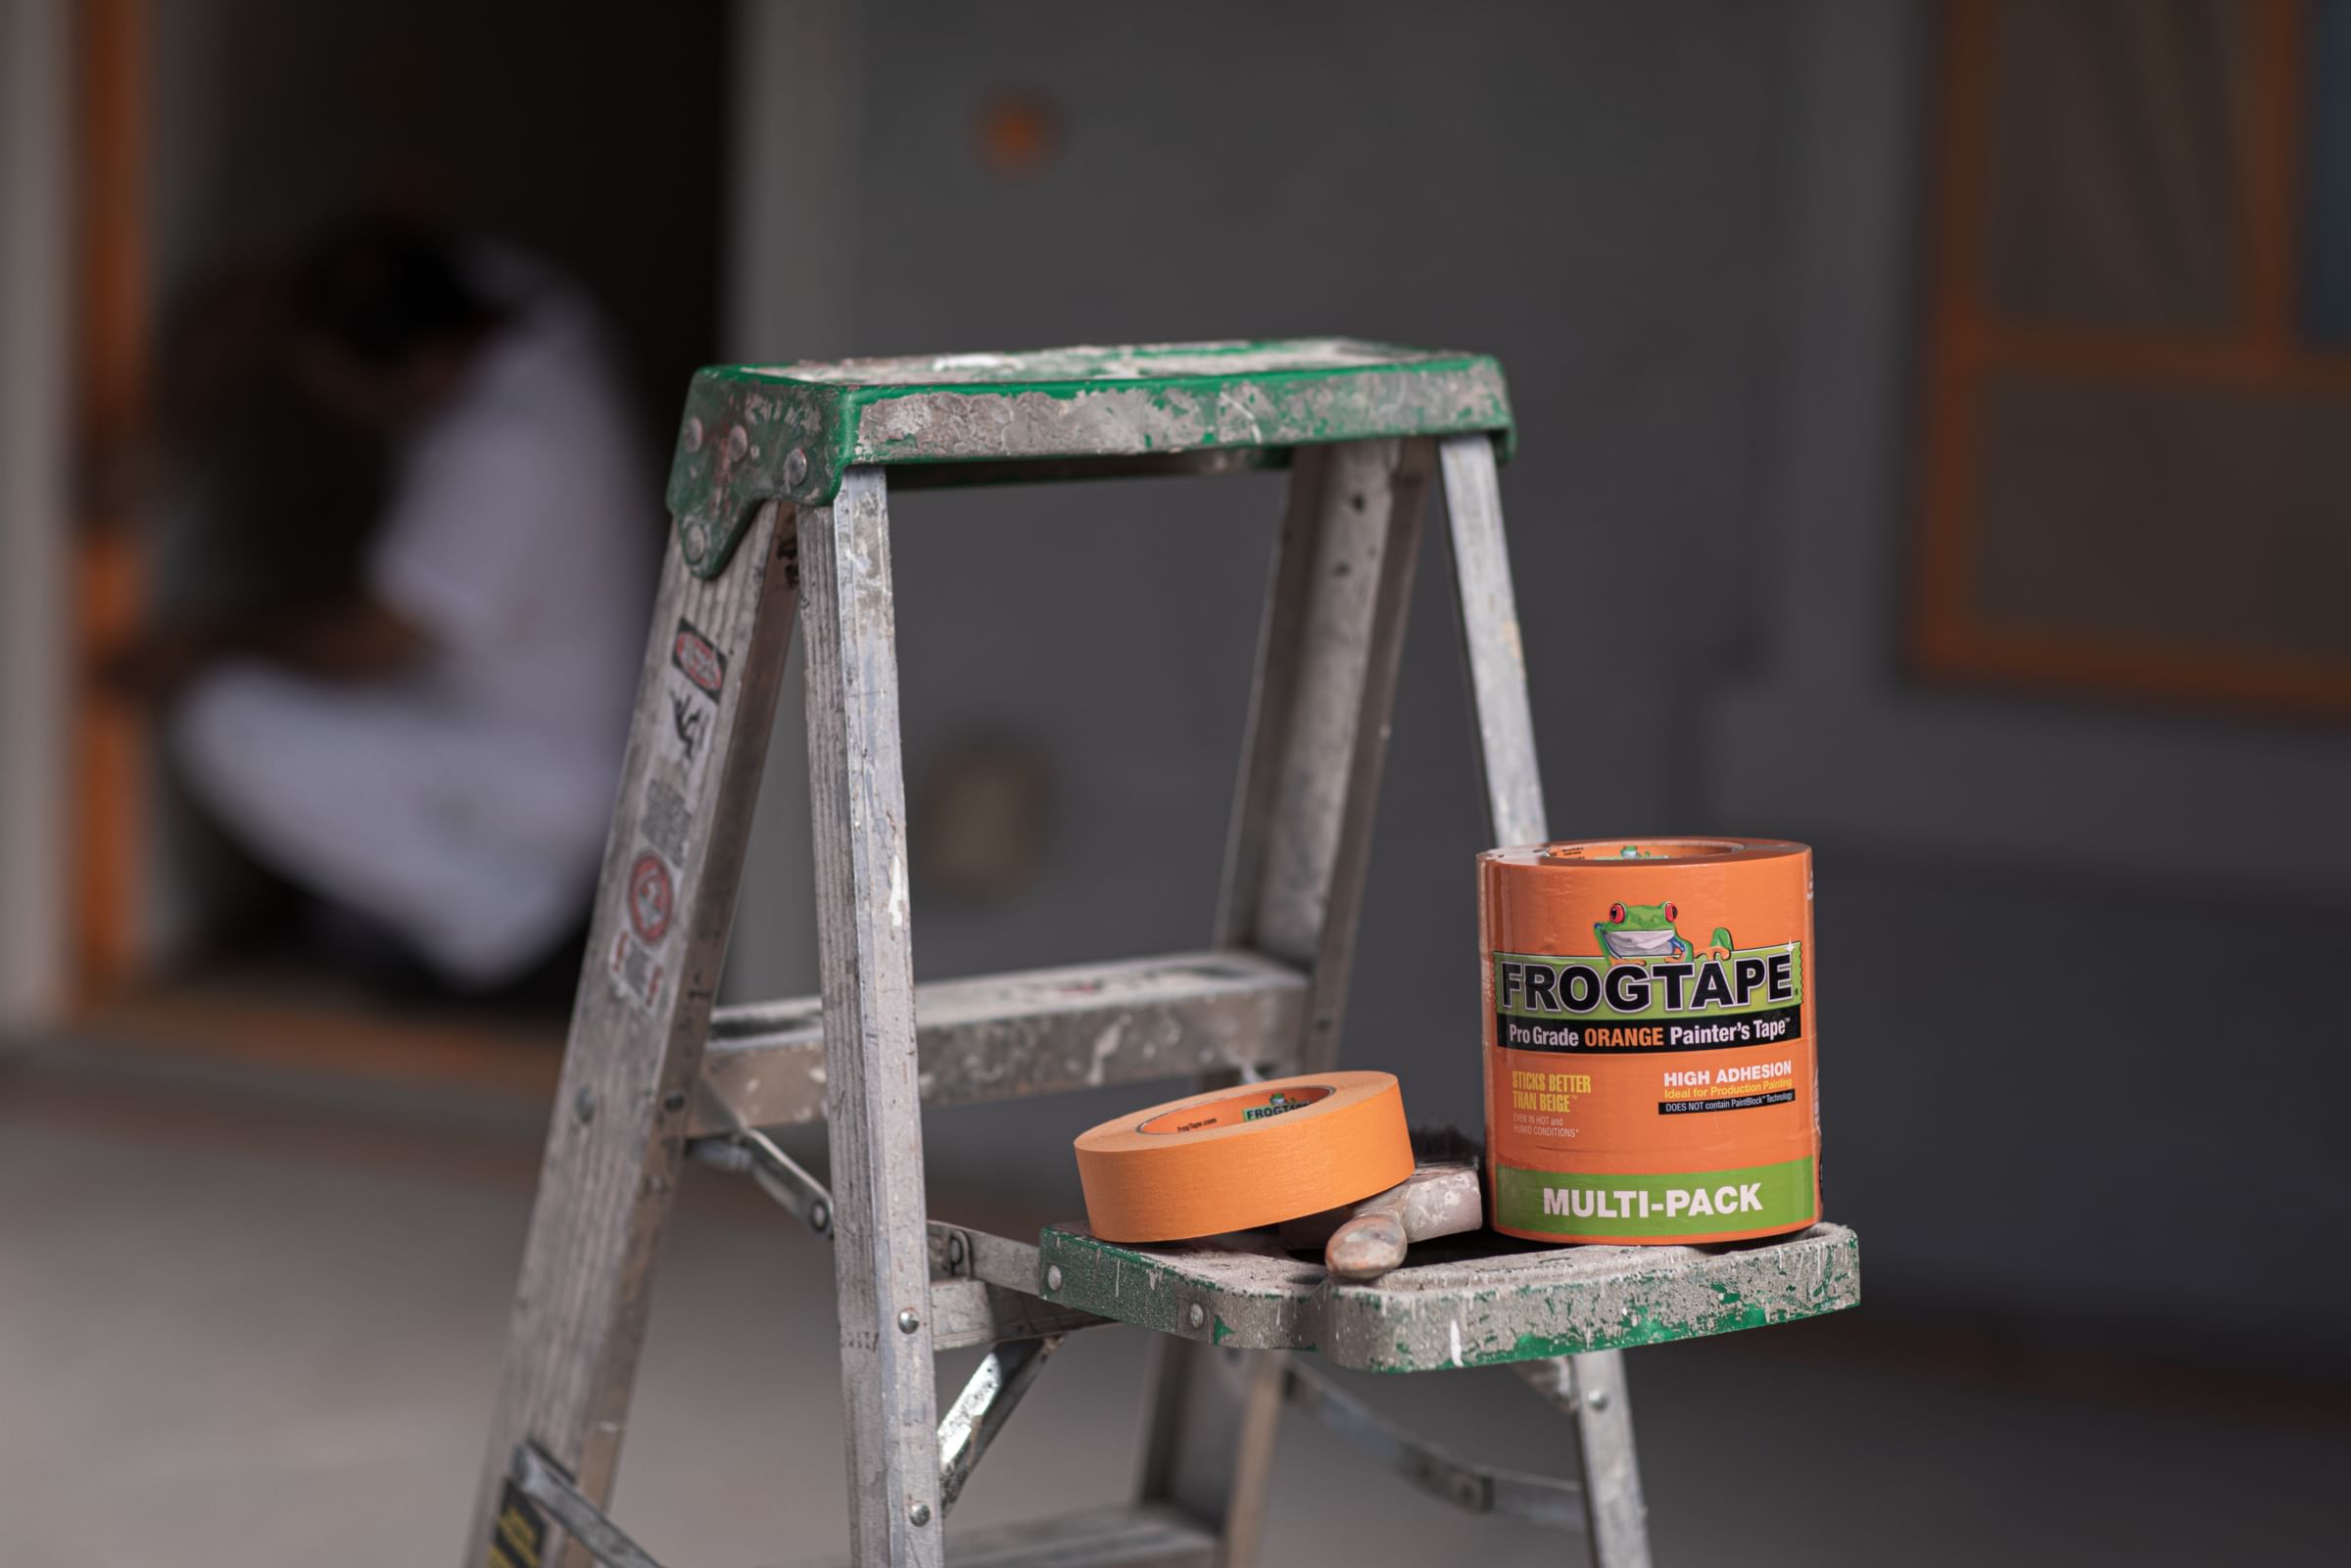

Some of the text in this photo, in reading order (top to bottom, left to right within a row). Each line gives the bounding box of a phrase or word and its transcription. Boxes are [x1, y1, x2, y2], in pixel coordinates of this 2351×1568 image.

[1502, 952, 1793, 1013] FROGTAPE
[1510, 1023, 1531, 1043] Pro
[1533, 1026, 1579, 1046] Grade
[1584, 1026, 1664, 1047] ORANGE
[1670, 1022, 1750, 1045] Painter's
[1512, 1070, 1591, 1093] STICKS BETTER
[1663, 1060, 1792, 1087] HIGH ADHESION
[1512, 1090, 1536, 1110] THAN
[1664, 1078, 1792, 1099] Ideal for Production Painting
[1665, 1103, 1687, 1113] DOES
[1689, 1101, 1703, 1111] NOT
[1705, 1100, 1730, 1110] contain
[1536, 1115, 1549, 1125] HOT
[1543, 1183, 1763, 1218] MULTI-PACK
